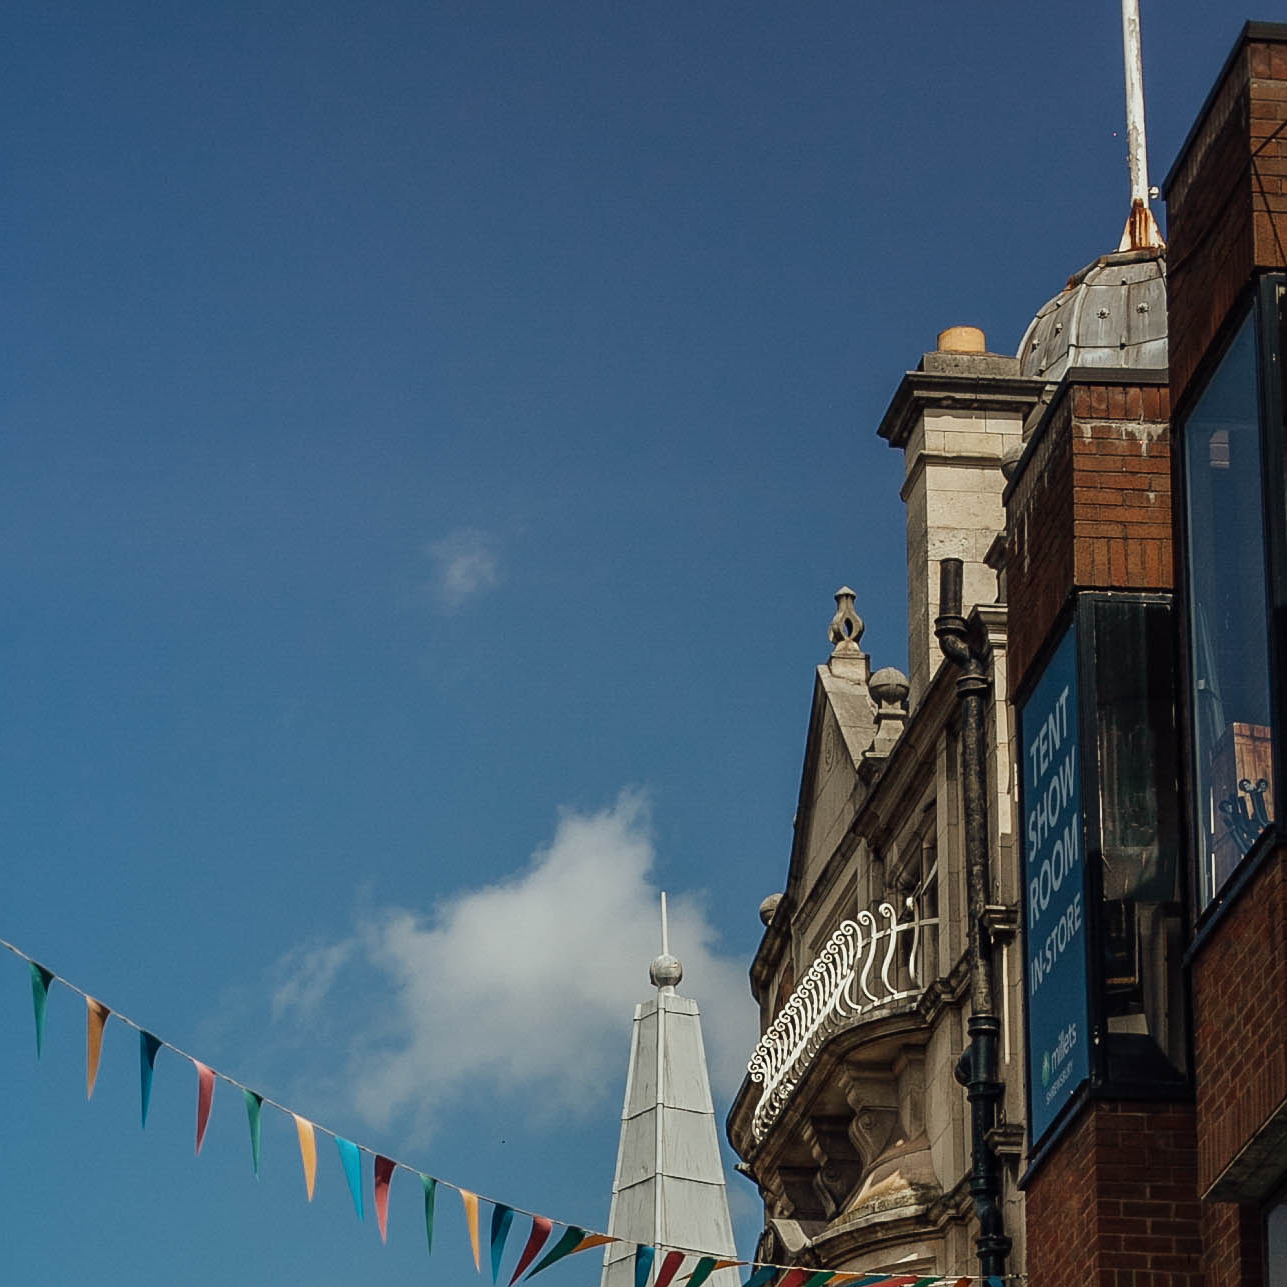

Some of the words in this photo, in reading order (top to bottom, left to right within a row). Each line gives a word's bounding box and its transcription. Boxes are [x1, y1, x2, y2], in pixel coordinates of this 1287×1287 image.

[1030, 685, 1069, 788] TENT
[1028, 745, 1075, 862] SHOW
[1029, 813, 1079, 929] ROOM
[1031, 893, 1082, 996] IN-STORE
[1051, 1023, 1077, 1073] millets
